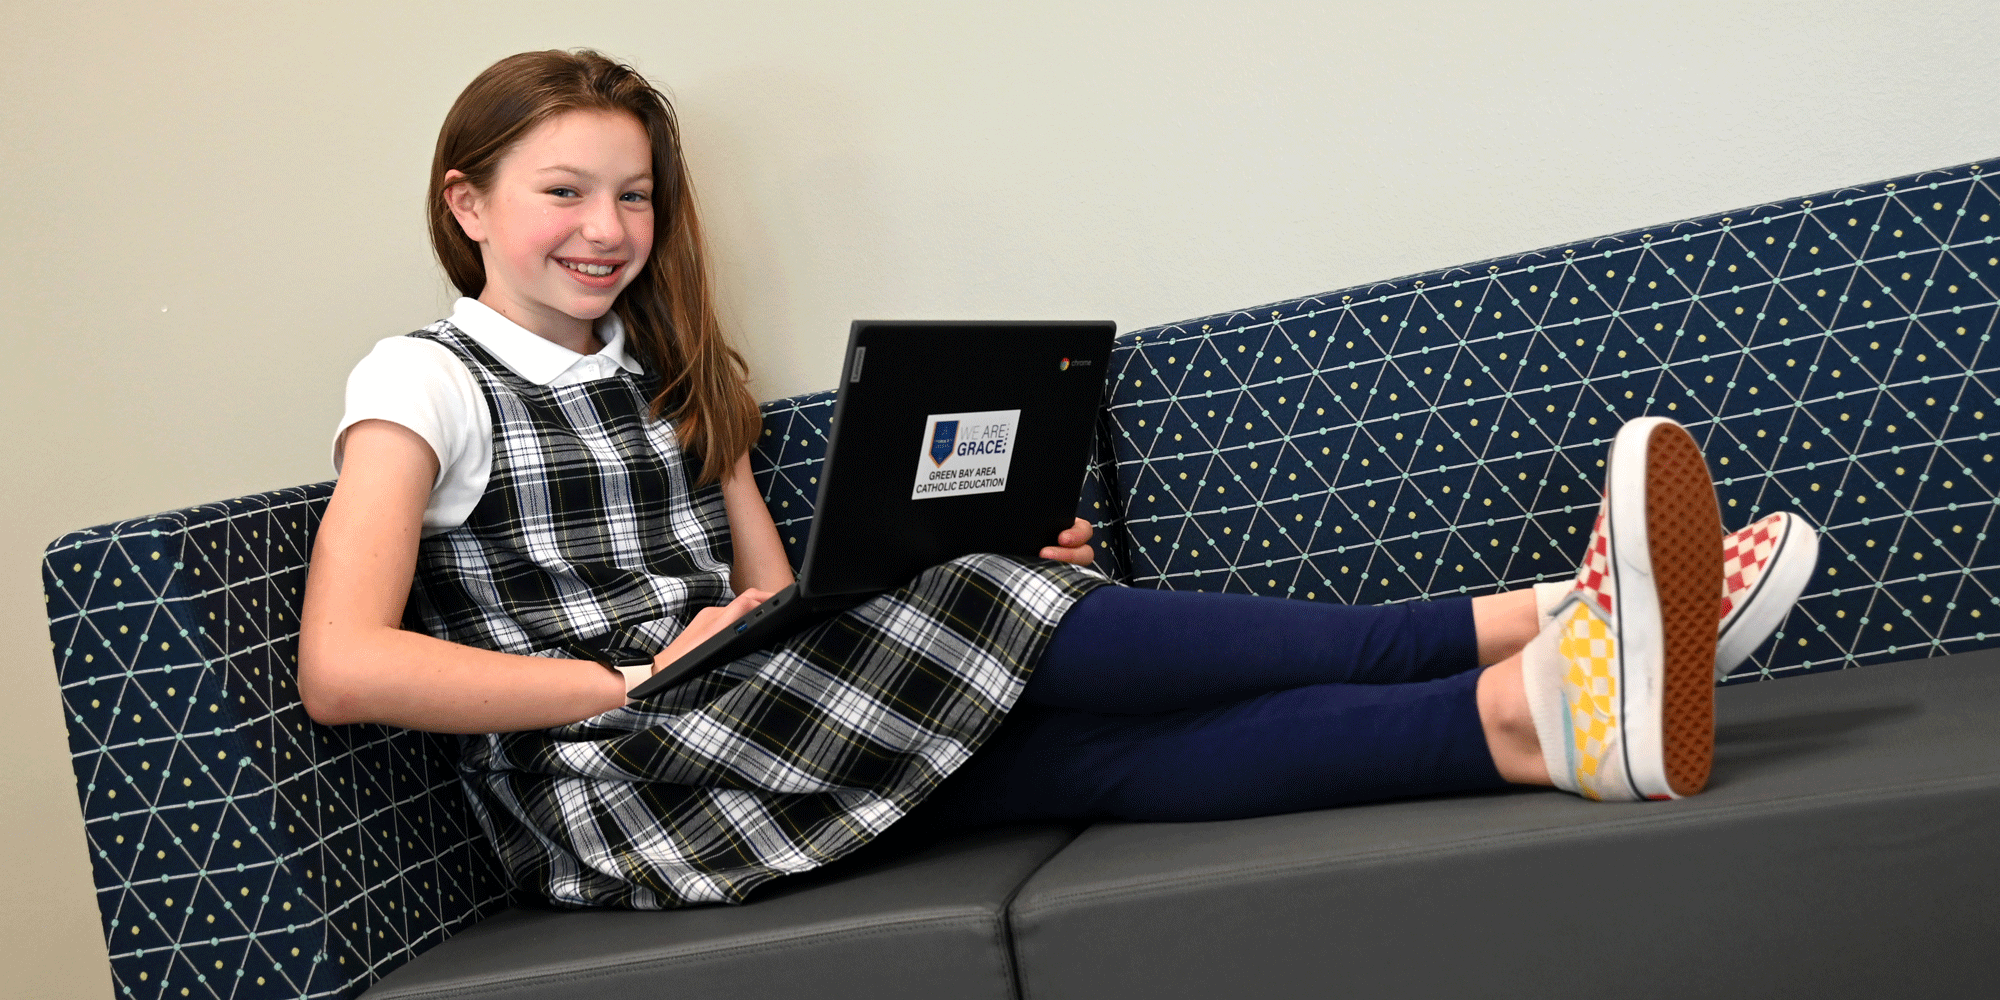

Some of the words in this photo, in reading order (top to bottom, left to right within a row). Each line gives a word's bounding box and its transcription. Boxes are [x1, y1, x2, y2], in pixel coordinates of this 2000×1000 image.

[1071, 359, 1092, 367] chrome
[960, 425, 980, 441] WE
[982, 424, 1007, 439] ARE
[929, 469, 957, 480] GREEN
[958, 468, 974, 478] BAY
[975, 467, 996, 477] AREA
[916, 481, 957, 494] CATHOLIC
[958, 477, 1005, 490] EDUCATION
